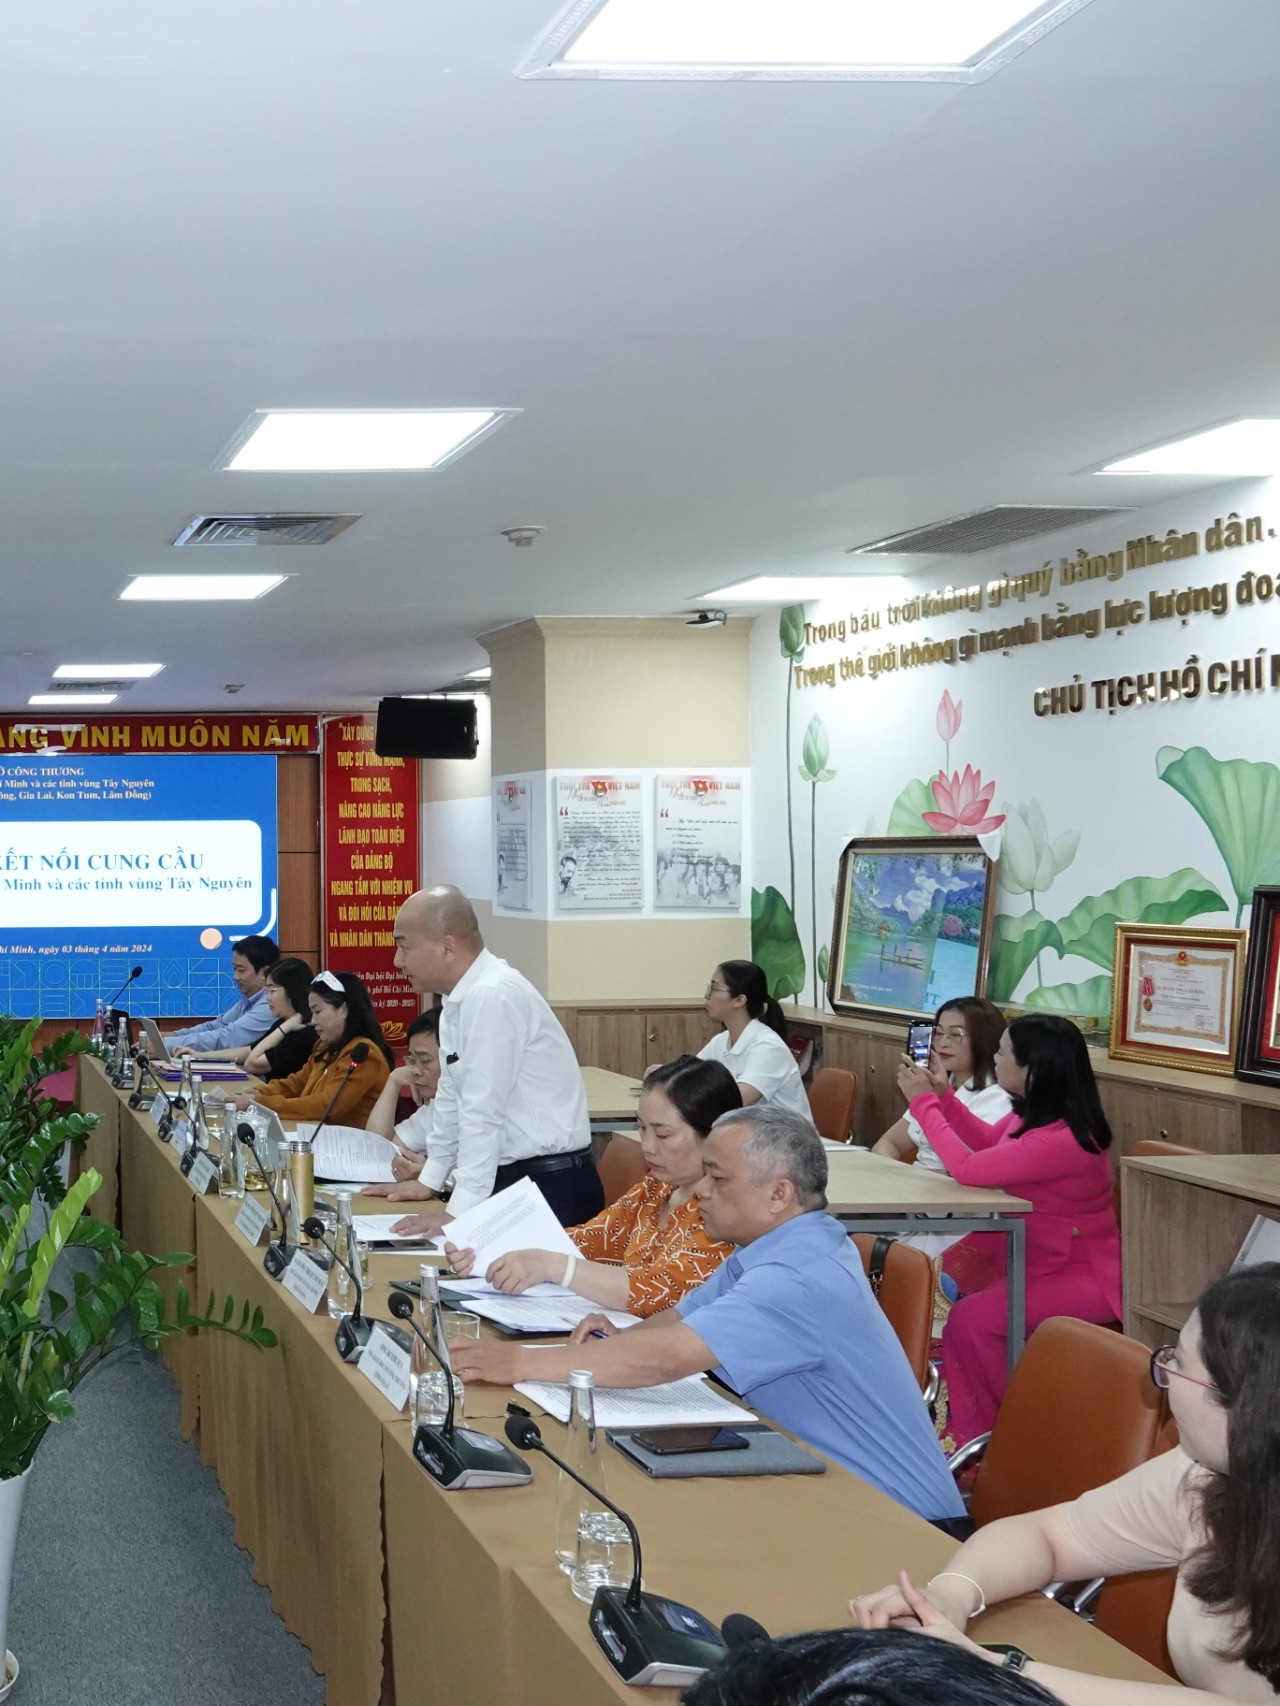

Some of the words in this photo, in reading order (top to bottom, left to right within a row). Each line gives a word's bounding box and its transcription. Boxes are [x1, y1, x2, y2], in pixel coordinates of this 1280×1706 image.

[804, 615, 846, 645] Trong
[887, 597, 921, 624] trời
[922, 585, 983, 617] không
[987, 572, 1009, 608] gì
[1010, 560, 1054, 602] quý
[1059, 548, 1124, 585] bằng
[1126, 529, 1200, 570] Nhân
[794, 663, 836, 689] Trong
[900, 637, 957, 666] không
[959, 628, 979, 661] gì
[980, 617, 1040, 657] mạnh
[1041, 602, 1102, 639] bằng
[1105, 599, 1145, 636] lực
[1149, 582, 1230, 627] lượng
[1033, 673, 1087, 717] CHỦ
[1091, 672, 1156, 715] TỊCH
[1160, 654, 1201, 700] HỒ
[1207, 647, 1267, 693] CHÍ
[60, 726, 130, 747] VINH
[141, 719, 230, 747] MUÔN
[242, 719, 310, 747] NĂM
[356, 725, 374, 744] DỰNG
[337, 750, 354, 770] THỰC
[355, 750, 364, 770] SỰ
[365, 748, 382, 766] VỮNG
[7, 766, 37, 776] CÔNG
[40, 767, 84, 776] THƯƠNG
[5, 779, 28, 788] Minh
[31, 780, 40, 788] và
[43, 780, 57, 788] các
[59, 779, 76, 788] tỉnh
[79, 780, 100, 790] vùng
[102, 779, 119, 789] Tây
[121, 779, 155, 789] Nguyên
[18, 791, 35, 800] Gia
[37, 791, 55, 800] Lai,
[56, 791, 75, 799] Kon
[76, 791, 101, 800] Tum,
[102, 790, 123, 799] Lâm
[125, 789, 152, 801] Đồng)
[350, 777, 371, 793] TRONG
[373, 777, 392, 796] SẠCH,
[339, 800, 357, 818] NÂNG
[358, 803, 371, 818] CAO
[372, 800, 391, 818] NĂNG
[392, 801, 404, 821] LỰC
[339, 826, 356, 844] LÃNH
[357, 829, 370, 847] ĐẠO
[371, 825, 388, 844] TOÀN
[389, 825, 405, 847] DIỆN
[40, 846, 80, 870] NỐI
[87, 854, 150, 870] CUNG
[158, 846, 204, 870] CẦU
[350, 849, 364, 870] CỦA
[365, 849, 383, 869] ĐẢNG
[384, 851, 393, 872] BỘ
[4, 879, 42, 890] Minh
[47, 878, 63, 890] và
[67, 878, 90, 890] các
[95, 877, 123, 890] tỉnh
[128, 877, 163, 892] vùng
[167, 877, 194, 892] Tây
[199, 876, 252, 892] Nguyên
[331, 880, 353, 895] NGANG
[355, 875, 368, 895] TẦM
[370, 876, 381, 895] VỚI
[382, 876, 403, 899] NHIỆM
[338, 903, 348, 922] VÀ
[348, 902, 360, 921] ĐÒI
[360, 901, 372, 921] HỎI
[373, 901, 387, 921] CỦA
[330, 928, 338, 947] VÀ
[340, 928, 358, 947] NHÂN
[359, 928, 373, 947] DÂN
[374, 928, 395, 947] THÀNH
[9, 945, 36, 954] Minh,
[38, 945, 59, 955] ngày
[61, 945, 72, 953] 03
[74, 945, 100, 955] tháng
[101, 945, 109, 953] 4
[109, 945, 129, 953] năm
[130, 944, 152, 953] 2024
